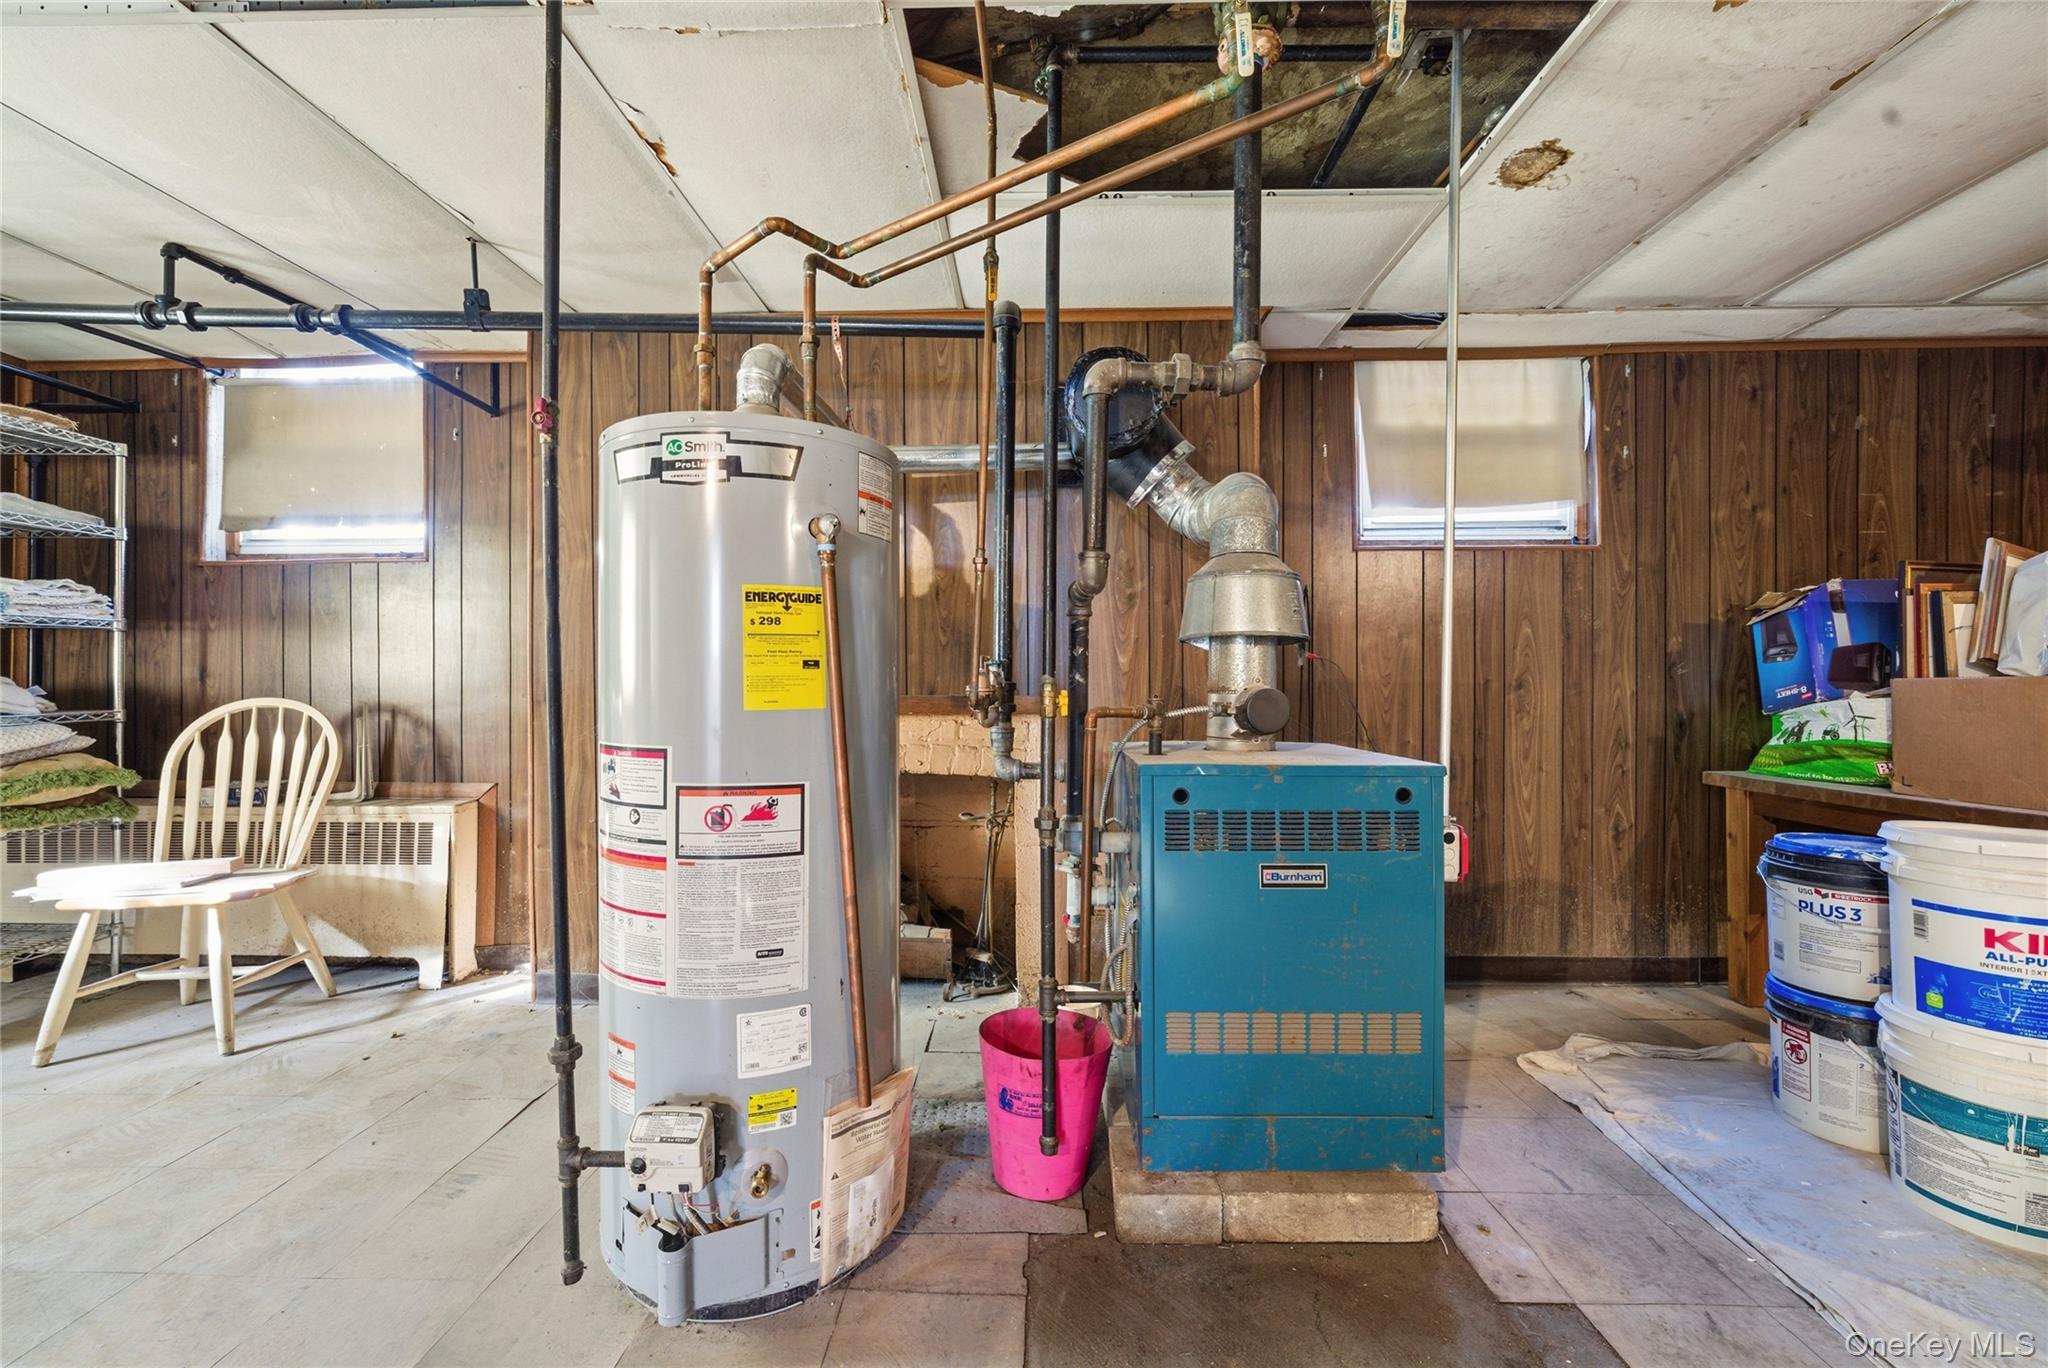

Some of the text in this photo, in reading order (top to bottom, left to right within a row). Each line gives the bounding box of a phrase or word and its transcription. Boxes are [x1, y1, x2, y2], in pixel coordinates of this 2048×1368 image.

[745, 591, 822, 604] ENERGYGUIDE
[759, 616, 782, 626] 298
[1271, 871, 1322, 881] Burnham
[1797, 886, 1814, 896] USG
[1798, 899, 1861, 921] PLUS 3
[1980, 961, 2023, 974] INTERIOR
